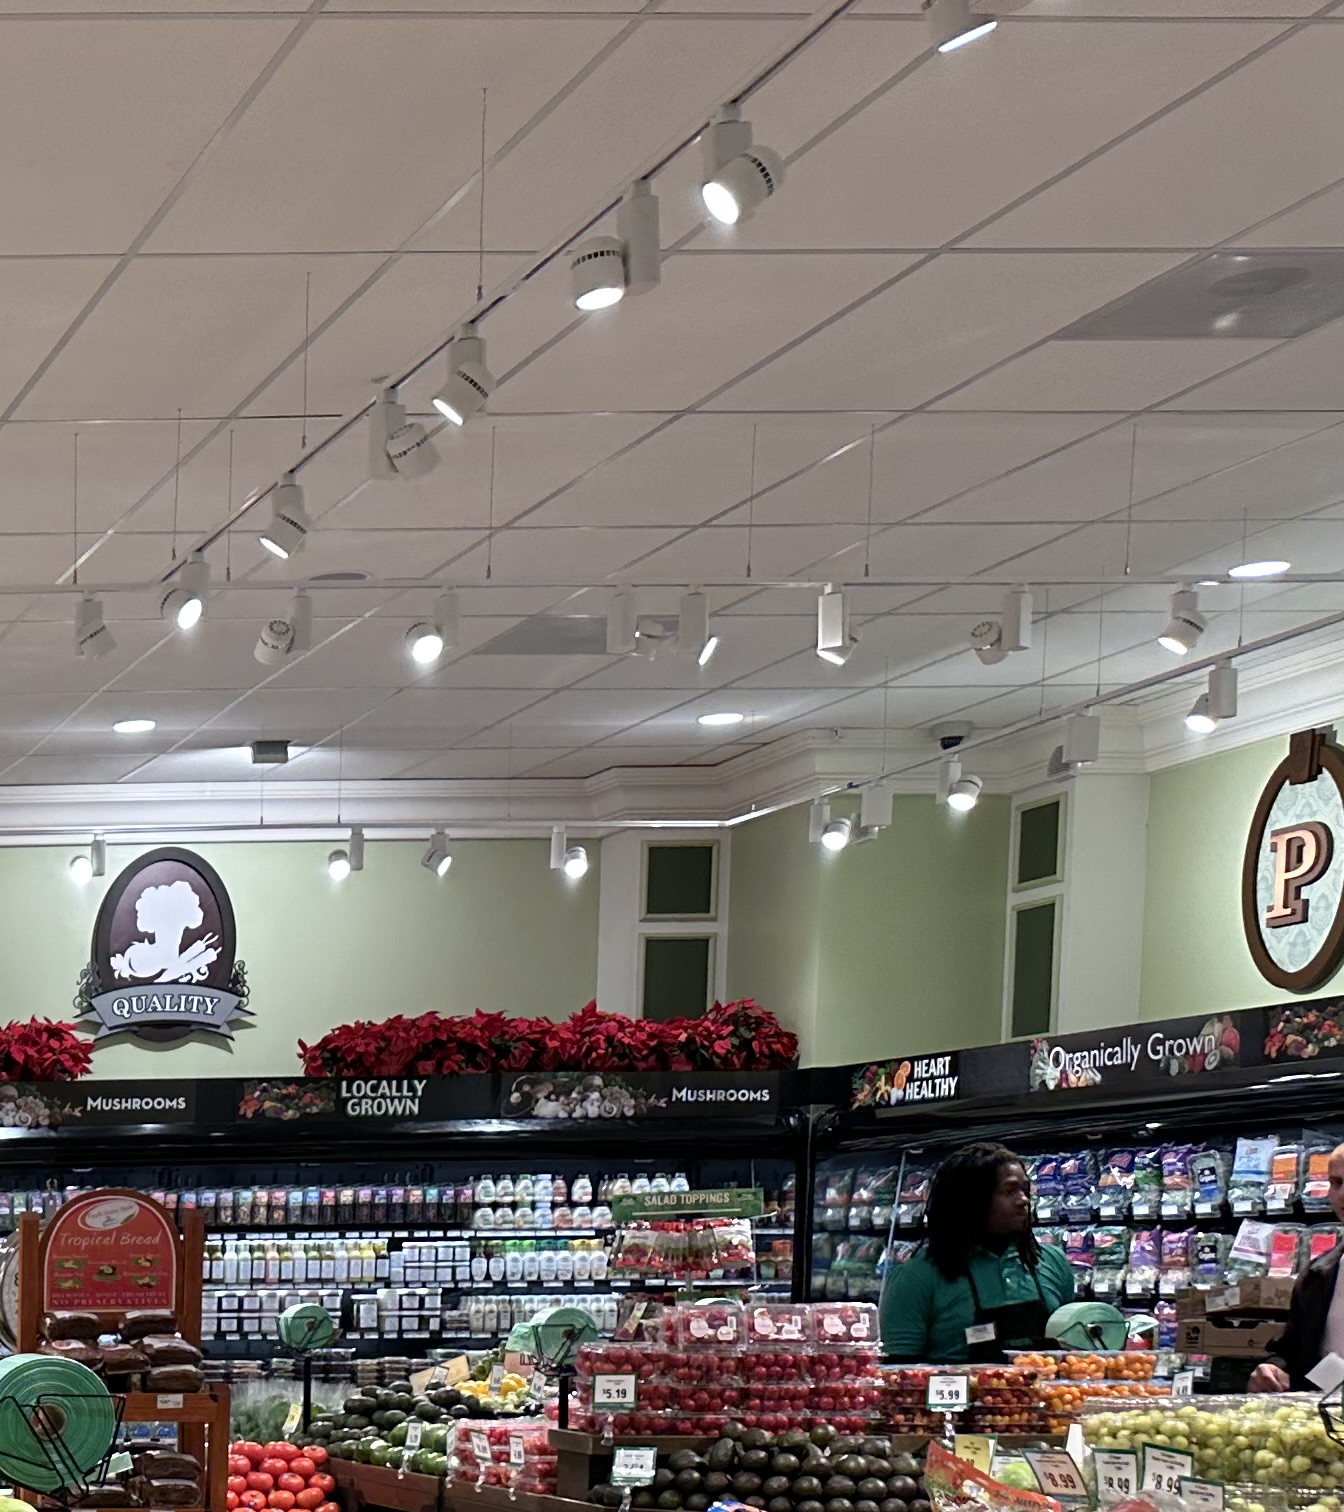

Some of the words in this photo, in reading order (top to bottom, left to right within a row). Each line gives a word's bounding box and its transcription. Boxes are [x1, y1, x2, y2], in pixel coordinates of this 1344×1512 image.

[1265, 821, 1334, 929] P
[111, 994, 220, 1018] QUALITY
[1049, 1037, 1141, 1077] Organically
[1147, 1032, 1215, 1061] Grown
[914, 1056, 951, 1078] HEART
[341, 1079, 427, 1097] LOCALLY
[906, 1076, 959, 1100] HEALTHY
[346, 1098, 419, 1116] GROWN
[644, 1195, 677, 1207] SALAD
[680, 1191, 731, 1205] TOPPINGS
[60, 1232, 115, 1250] Tropical
[120, 1230, 162, 1245] Bread
[936, 1389, 960, 1400] $5.99
[1043, 1471, 1076, 1490] $8.99
